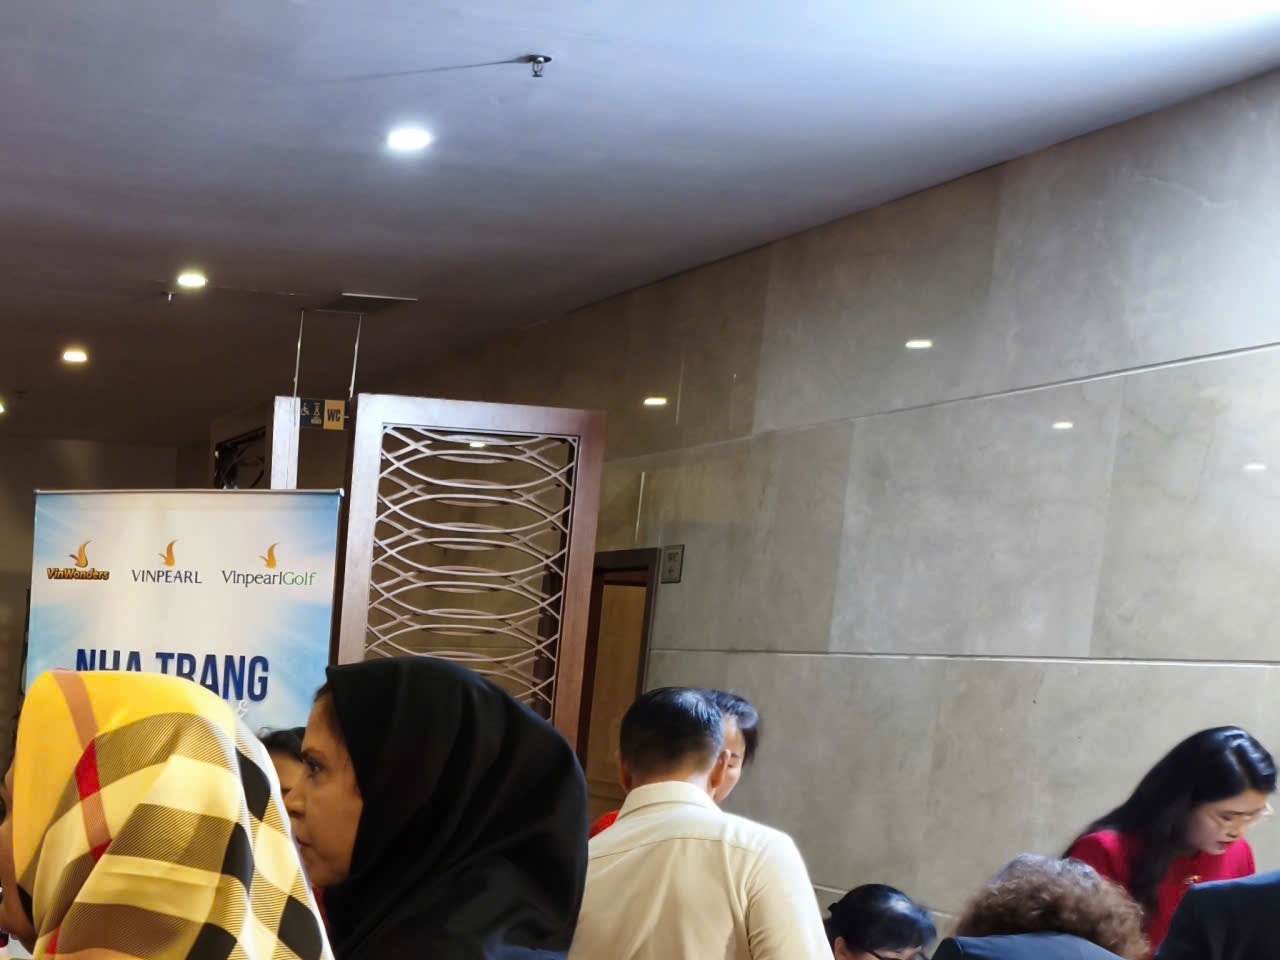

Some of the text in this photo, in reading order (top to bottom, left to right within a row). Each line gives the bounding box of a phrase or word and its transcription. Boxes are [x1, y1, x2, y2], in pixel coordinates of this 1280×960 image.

[327, 408, 342, 422] WC
[47, 567, 110, 580] VinWonders
[131, 569, 202, 584] VINPEARL
